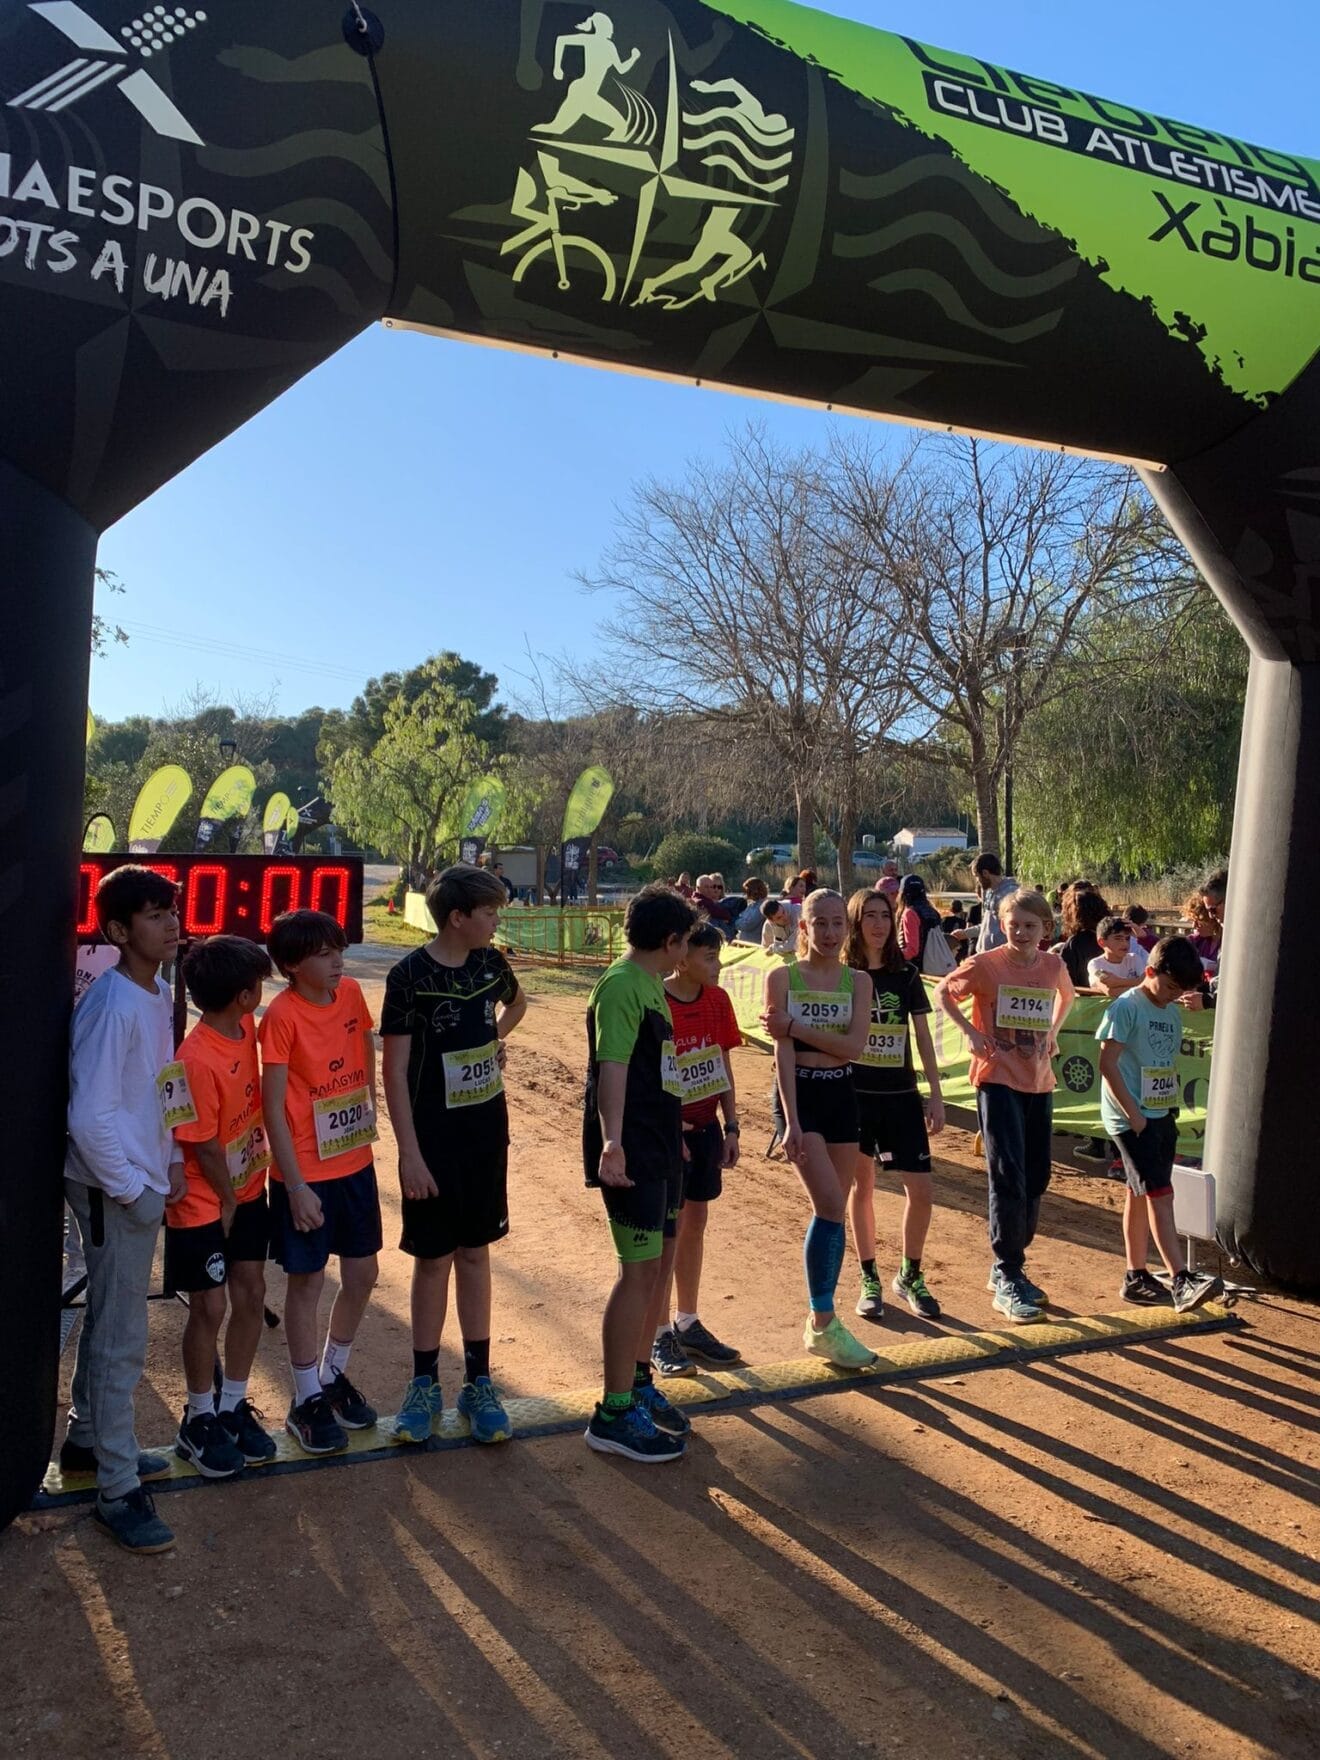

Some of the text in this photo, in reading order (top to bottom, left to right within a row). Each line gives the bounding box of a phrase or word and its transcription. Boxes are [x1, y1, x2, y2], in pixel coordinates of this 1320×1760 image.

[934, 79, 1320, 219] CLUB ATLETISME
[90, 240, 129, 293] A
[143, 252, 233, 318] UNA
[801, 1003, 839, 1017] 2059
[1010, 997, 1043, 1012] 2194
[867, 1034, 895, 1048] 033
[681, 1059, 715, 1082] 2050
[811, 1069, 844, 1080] PRO
[328, 1104, 362, 1130] 2020
